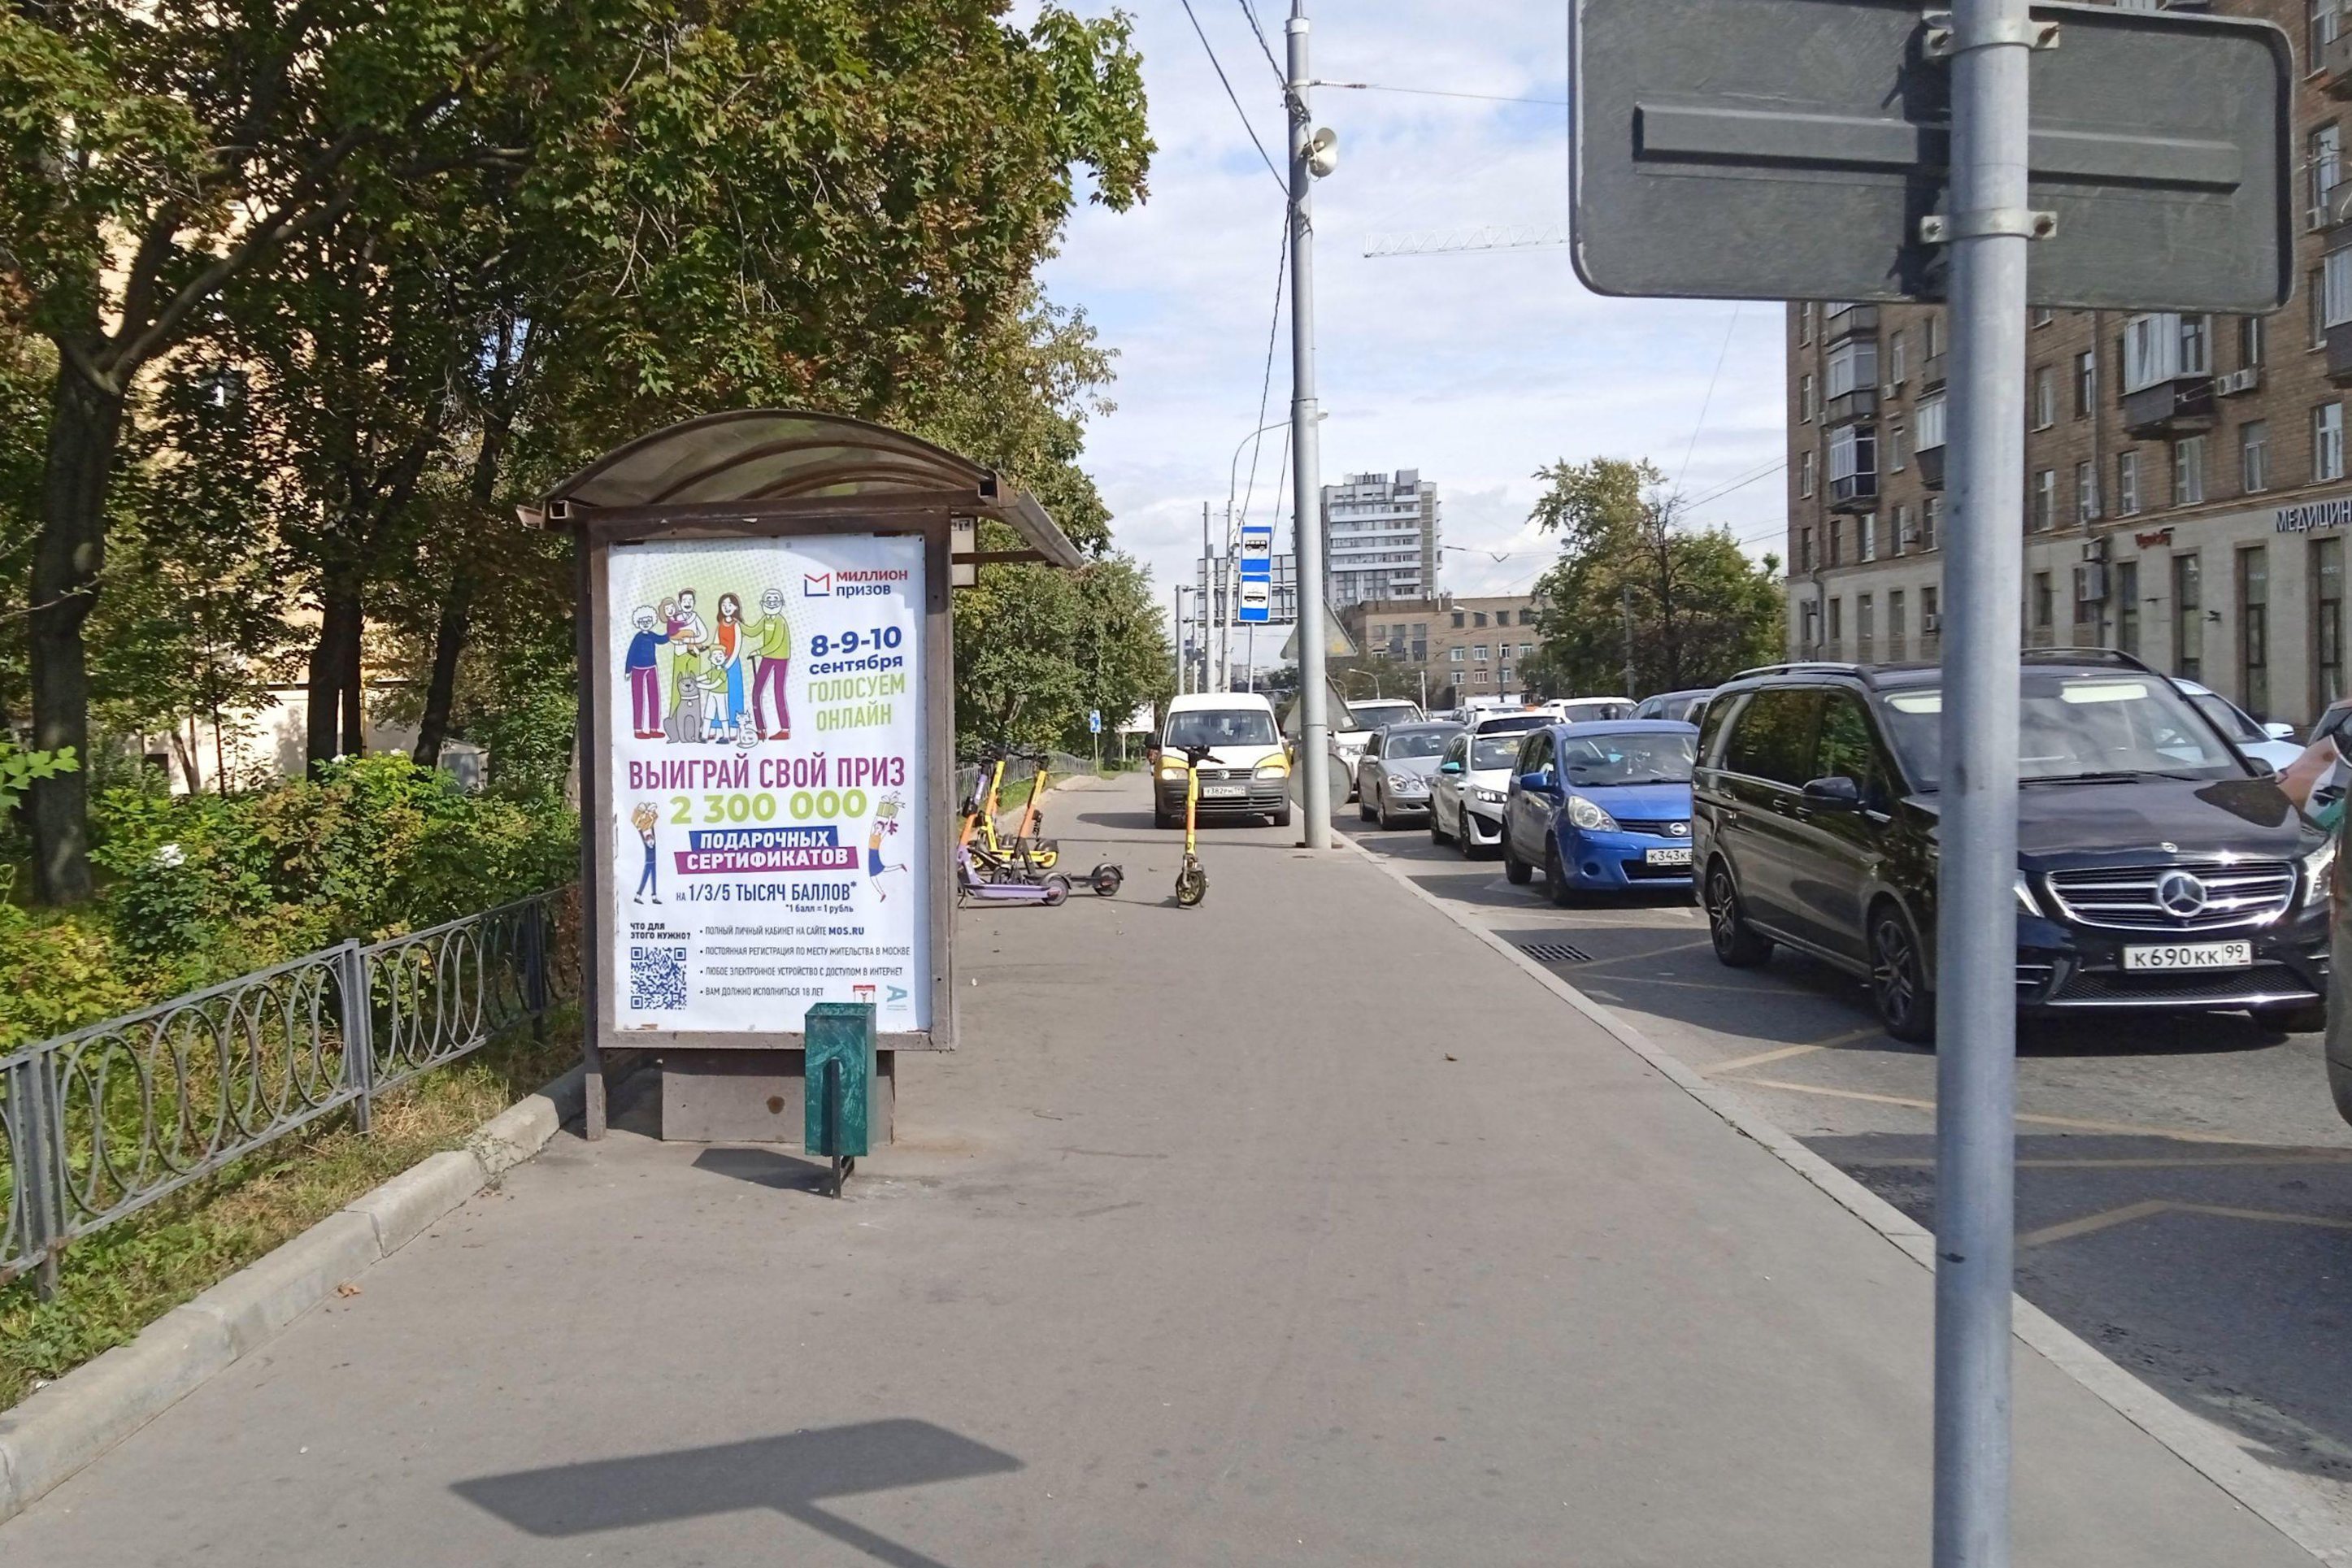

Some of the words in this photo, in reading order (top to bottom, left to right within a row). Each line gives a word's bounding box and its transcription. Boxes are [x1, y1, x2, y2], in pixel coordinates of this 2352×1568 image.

[837, 584, 891, 598] призов
[811, 626, 902, 657] 8-9-10
[809, 654, 903, 675] сентября
[808, 672, 905, 703] ГОЛОСУЕМ
[816, 700, 892, 732] ОНЛАЙН
[629, 753, 749, 789] ВЫИГРАЙ
[759, 752, 827, 788] СВОЙ
[837, 757, 905, 788] ПРИЗ
[670, 796, 692, 824] 2
[703, 793, 776, 823] 300
[789, 789, 867, 820] 000
[700, 831, 830, 851] ПОДАРОЧНЫХ
[687, 848, 848, 870] СЕРТИФИКАТОВ
[676, 893, 686, 901] НА
[689, 884, 731, 901] 1/3/5
[736, 884, 786, 901] ТЫСЯЧ
[795, 903, 815, 913] балл
[829, 904, 854, 914] рубль
[647, 923, 665, 931] ДЛЯ
[705, 925, 733, 935] ПОЛНЫЙ
[735, 925, 763, 935] ЛИЧНЫЙ
[765, 926, 794, 935] КАБИНЕТ
[796, 927, 805, 935] НА
[806, 925, 826, 935] САЙТЕ
[828, 927, 864, 935] MOS.RU
[705, 946, 748, 955] ПОСТОЯННАЯ
[749, 946, 795, 957] РЕГИСТРАЦИЯ
[796, 947, 805, 955] ПО
[806, 947, 828, 956] МЕСТУ
[830, 947, 874, 956] ЖИТЕЛЬСТВА
[876, 947, 880, 955] В
[882, 947, 911, 955] МОСКВЕ
[2134, 948, 2219, 966] К690КК
[2225, 945, 2244, 958] 99
[706, 966, 728, 975] ЛЮБОЕ
[730, 966, 776, 975] ЭЛЕКТРОННОЕ
[777, 966, 818, 976] УСТРОЙСТВО
[820, 967, 825, 975] С
[826, 967, 861, 976] ДОСТУПОМ
[863, 967, 867, 975] В
[870, 967, 902, 975] ИНТЕРНЕТ
[706, 987, 720, 996] ВАМ
[721, 987, 752, 997] ДОЛЖНО
[753, 987, 800, 996] ИСПОЛНИТЬСЯ
[802, 988, 810, 996] 18
[811, 988, 824, 996] ЛЕТ
